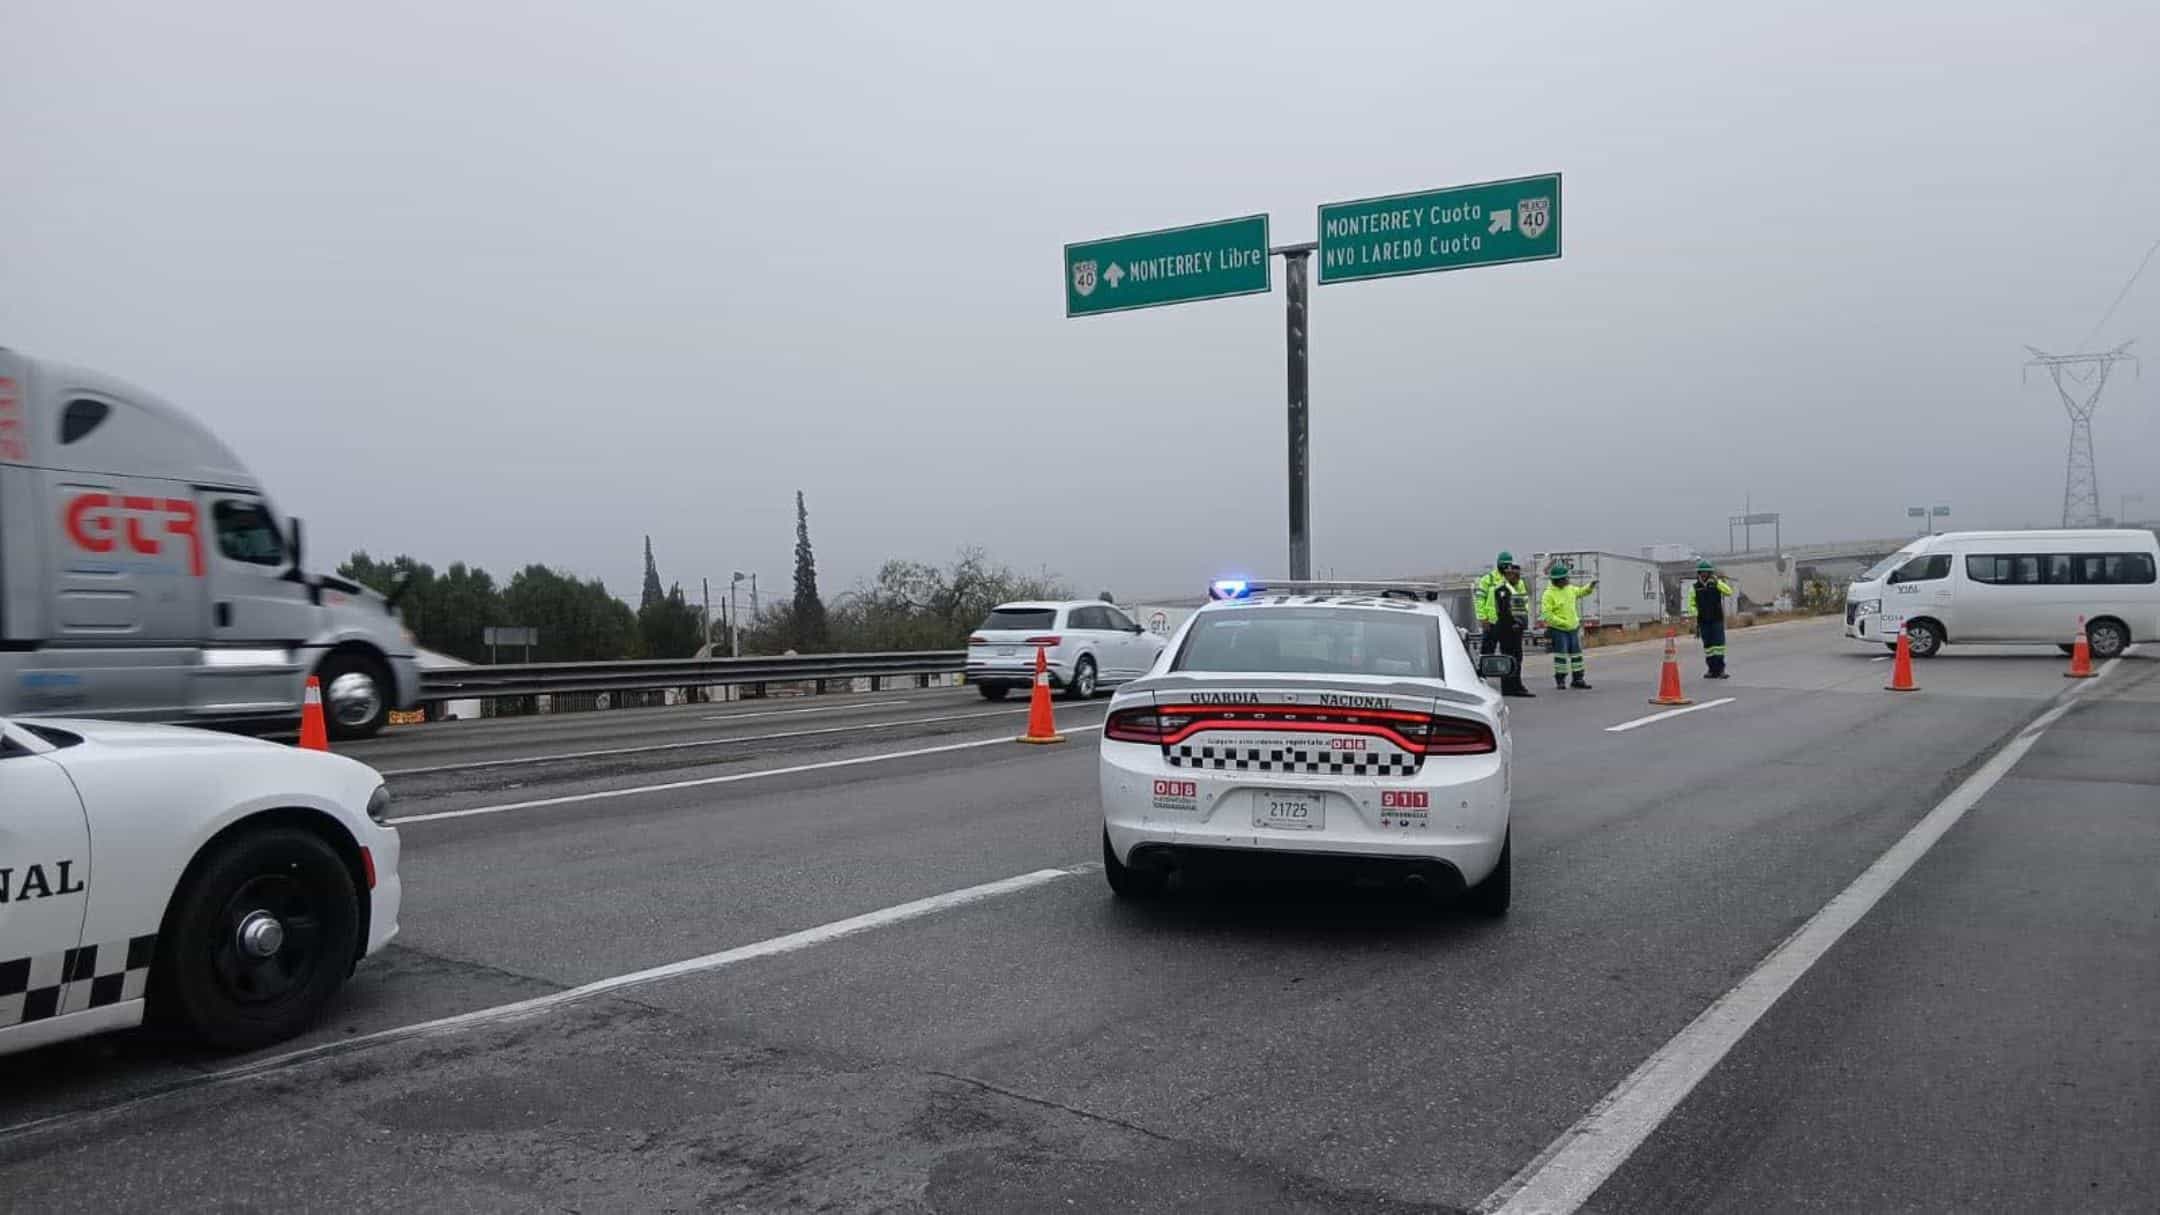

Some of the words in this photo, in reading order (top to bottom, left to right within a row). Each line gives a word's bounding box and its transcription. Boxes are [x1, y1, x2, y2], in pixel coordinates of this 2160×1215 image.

[1326, 208, 1424, 238] MONTERREY
[1430, 203, 1481, 224] Cuota
[1523, 211, 1545, 226] 40
[1326, 247, 1355, 268] NVO
[1361, 240, 1423, 263] LAREDO
[1430, 234, 1481, 254] Cuota
[1130, 252, 1212, 281] MONTERREY
[1220, 248, 1261, 269] Libre
[1077, 272, 1094, 287] 40
[1190, 692, 1260, 704] GUARDIA
[1319, 693, 1392, 709] NACIONAL
[1155, 781, 1194, 796] 088
[1383, 792, 1425, 806] 911
[1270, 801, 1308, 817] 21725
